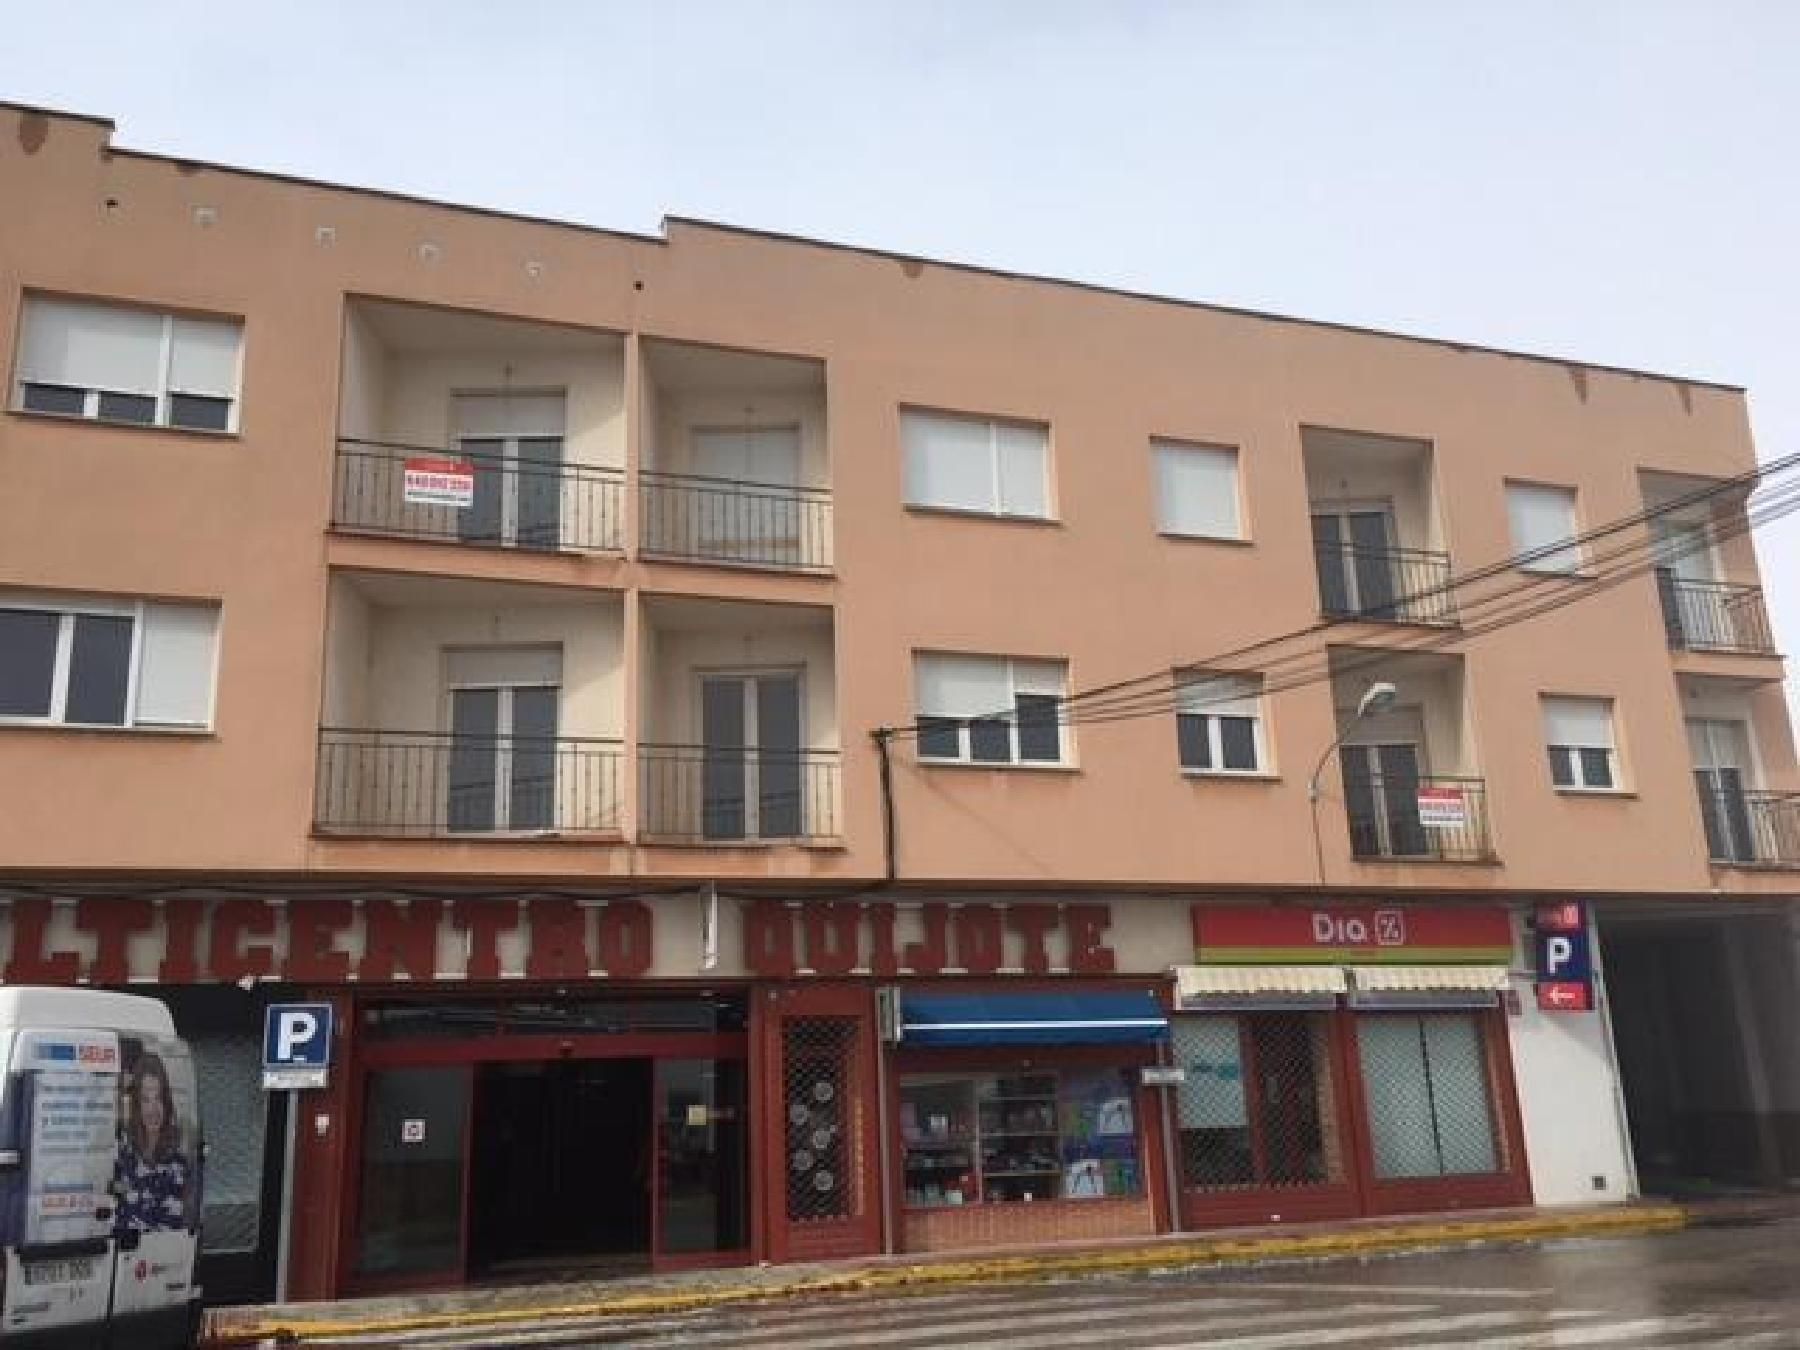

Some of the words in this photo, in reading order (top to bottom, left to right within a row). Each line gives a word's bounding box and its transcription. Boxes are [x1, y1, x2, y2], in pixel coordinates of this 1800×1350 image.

[744, 901, 1115, 974] QUIJOTE
[1312, 913, 1367, 943] Dia
[1547, 937, 1572, 975] P
[278, 1012, 318, 1060] P
